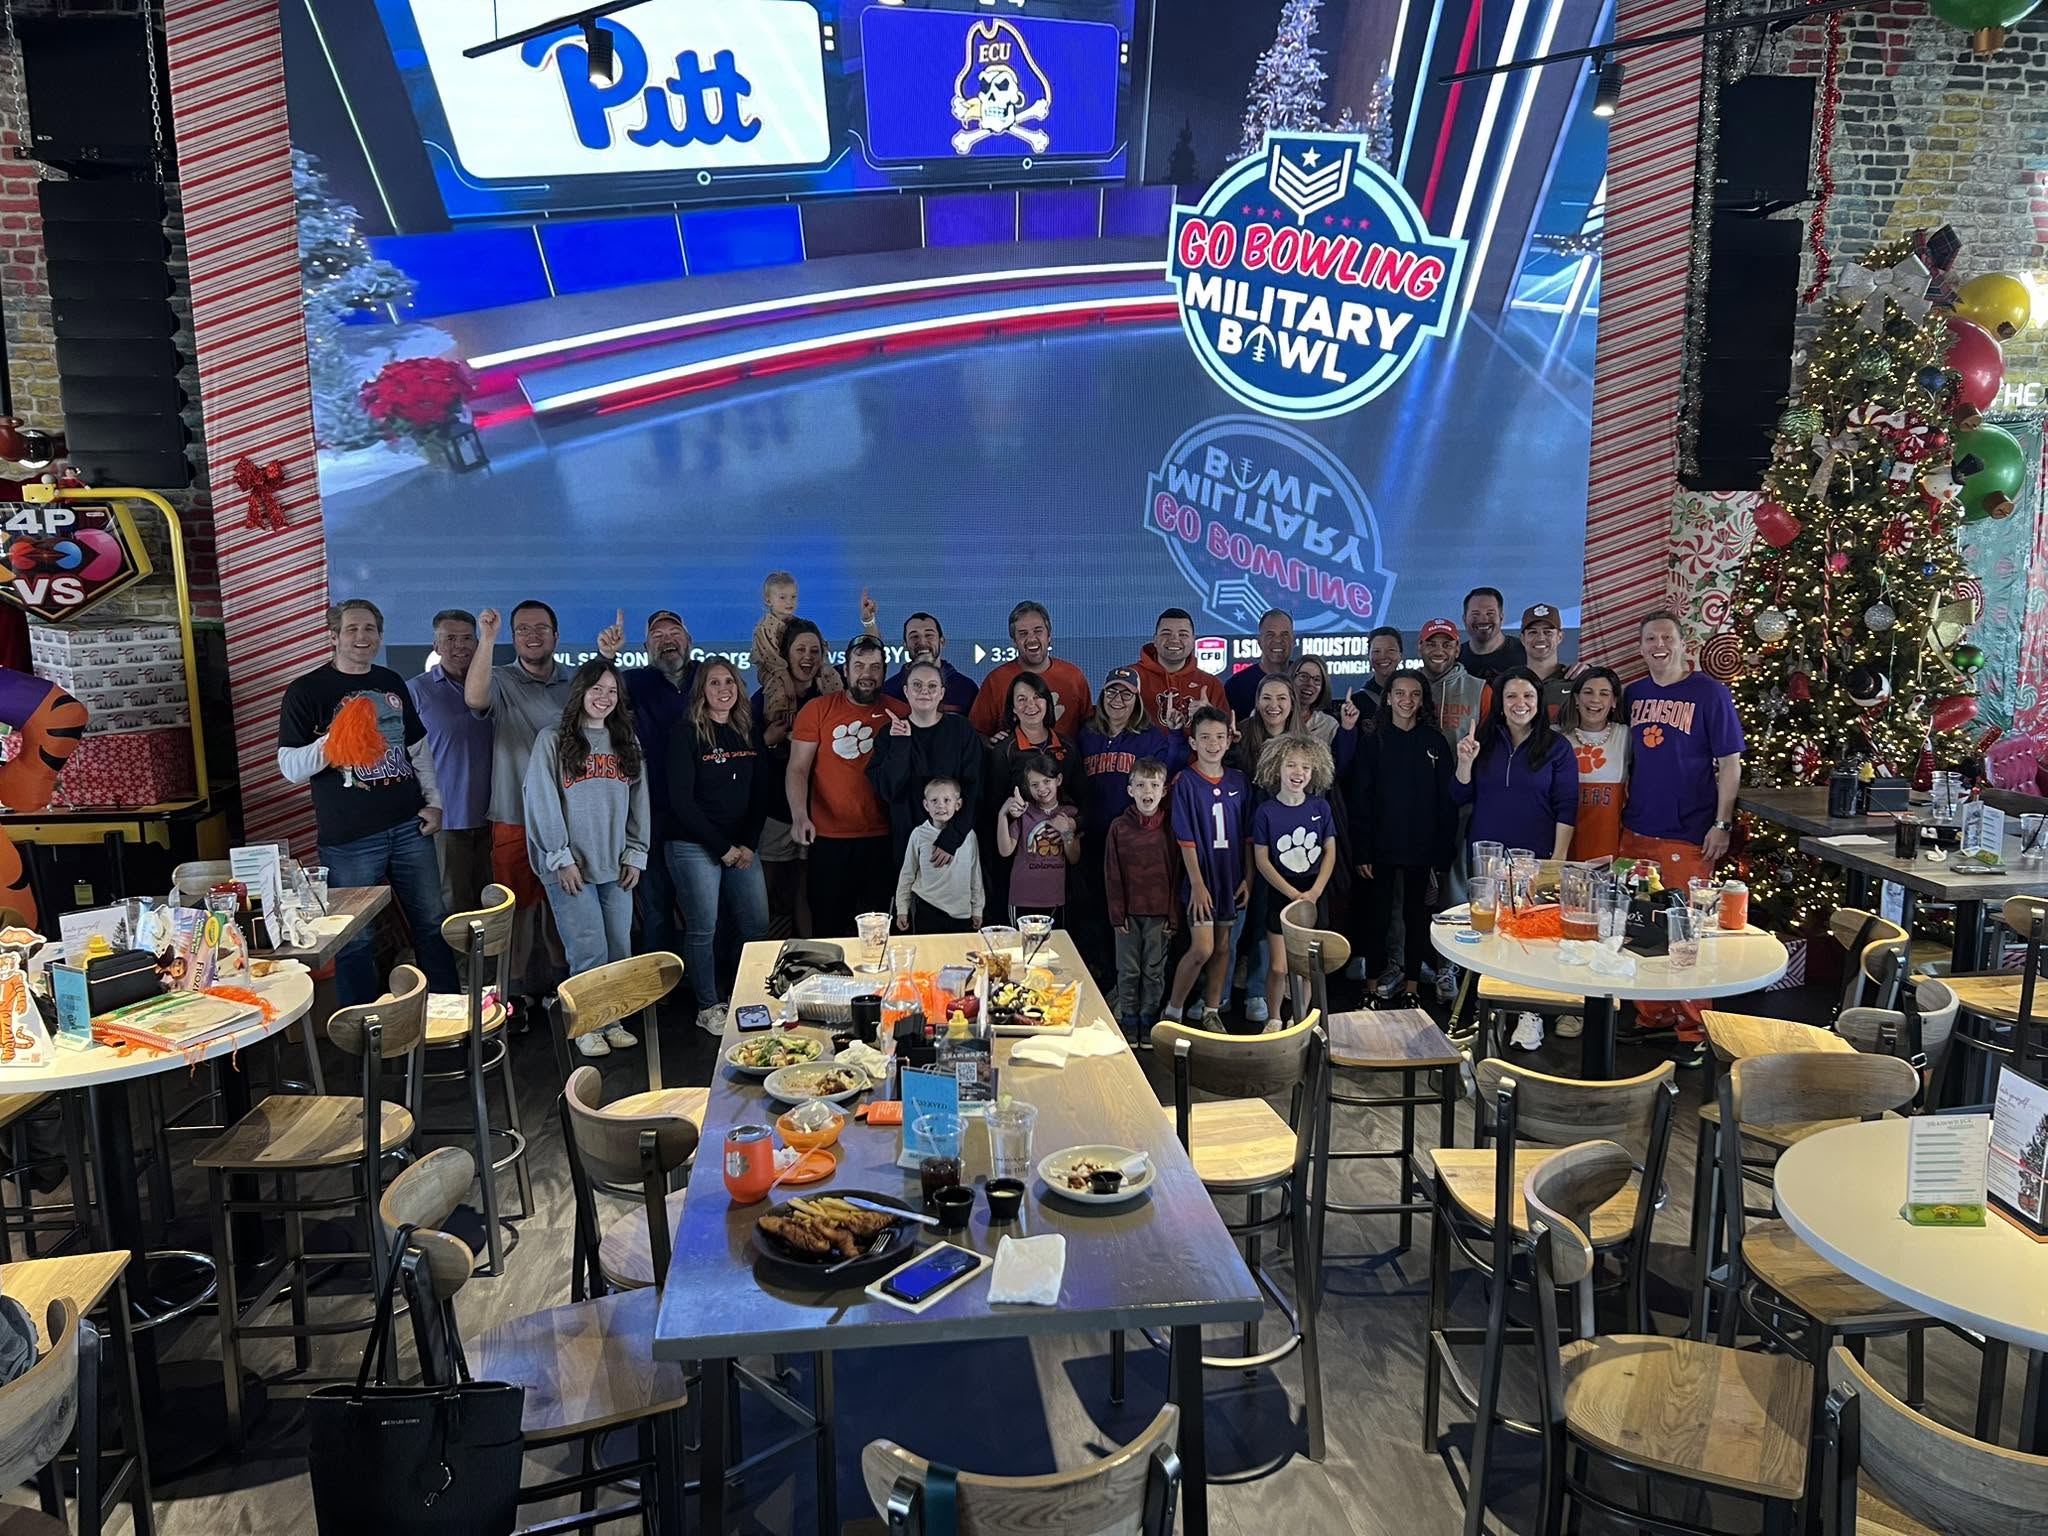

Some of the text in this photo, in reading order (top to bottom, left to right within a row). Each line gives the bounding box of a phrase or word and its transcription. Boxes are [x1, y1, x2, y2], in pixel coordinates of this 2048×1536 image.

[978, 42, 1011, 63] ECU
[521, 17, 762, 150] Pitt
[1178, 217, 1446, 300] GO BOWLING
[1185, 272, 1414, 351] MILITARY
[5, 508, 76, 534] 4P
[14, 577, 85, 605] VS
[577, 651, 649, 668] SSON
[991, 647, 1019, 662] 3:3
[1233, 638, 1263, 659] LSU
[1326, 660, 1374, 675] TONIGH
[1631, 699, 1696, 735] CLEMSON
[1212, 802, 1229, 849] 1
